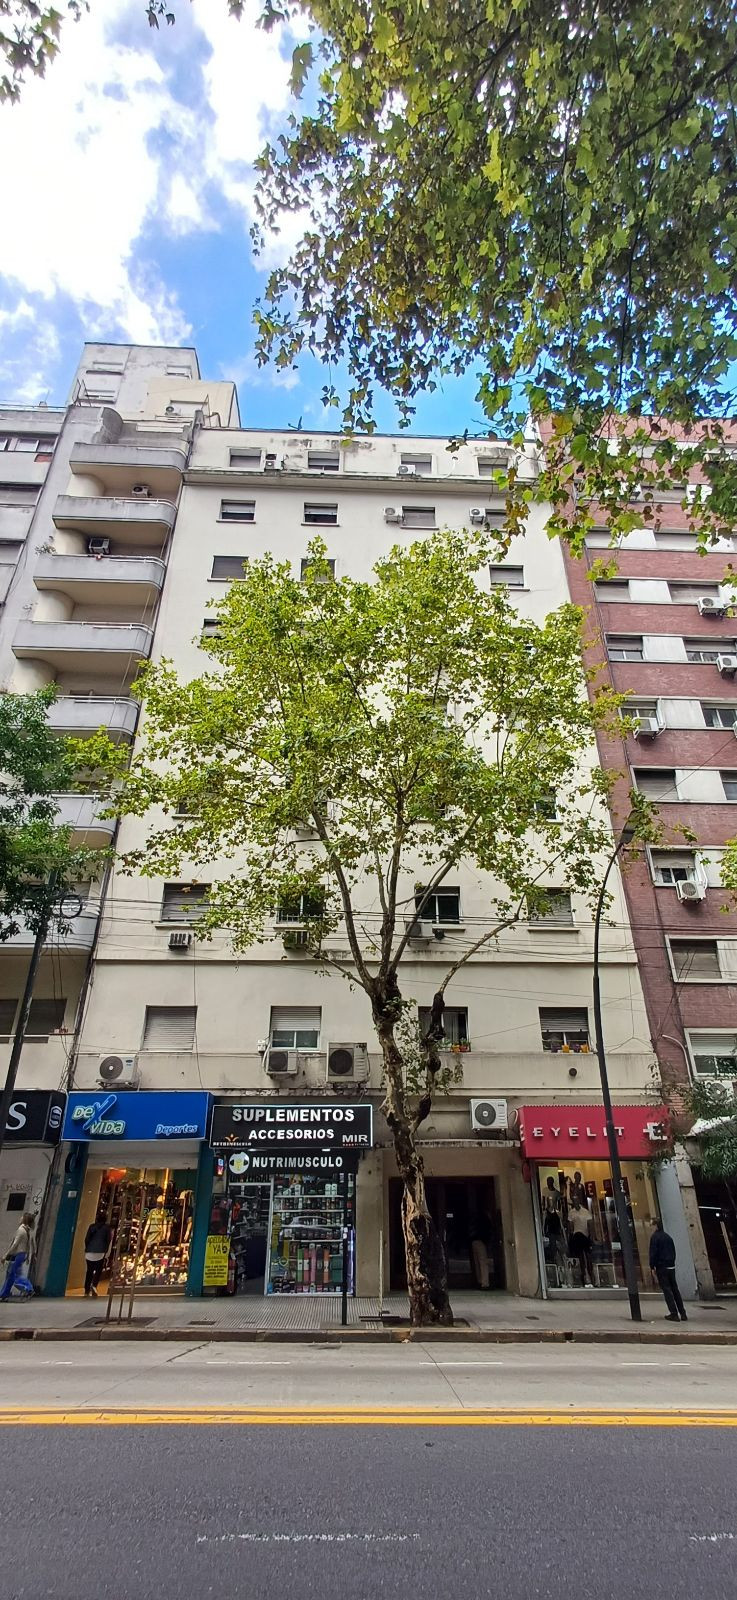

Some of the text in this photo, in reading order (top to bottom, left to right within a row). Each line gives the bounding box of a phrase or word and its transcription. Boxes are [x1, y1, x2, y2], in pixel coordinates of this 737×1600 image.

[232, 1108, 355, 1122] SUPLEMENTOS
[155, 1123, 198, 1136] Deportes
[248, 1129, 335, 1140] ACCESORIOS
[532, 1126, 625, 1137] EYELIT
[342, 1134, 369, 1143] MIR
[252, 1156, 343, 1168] NUTRIMUSCULO
